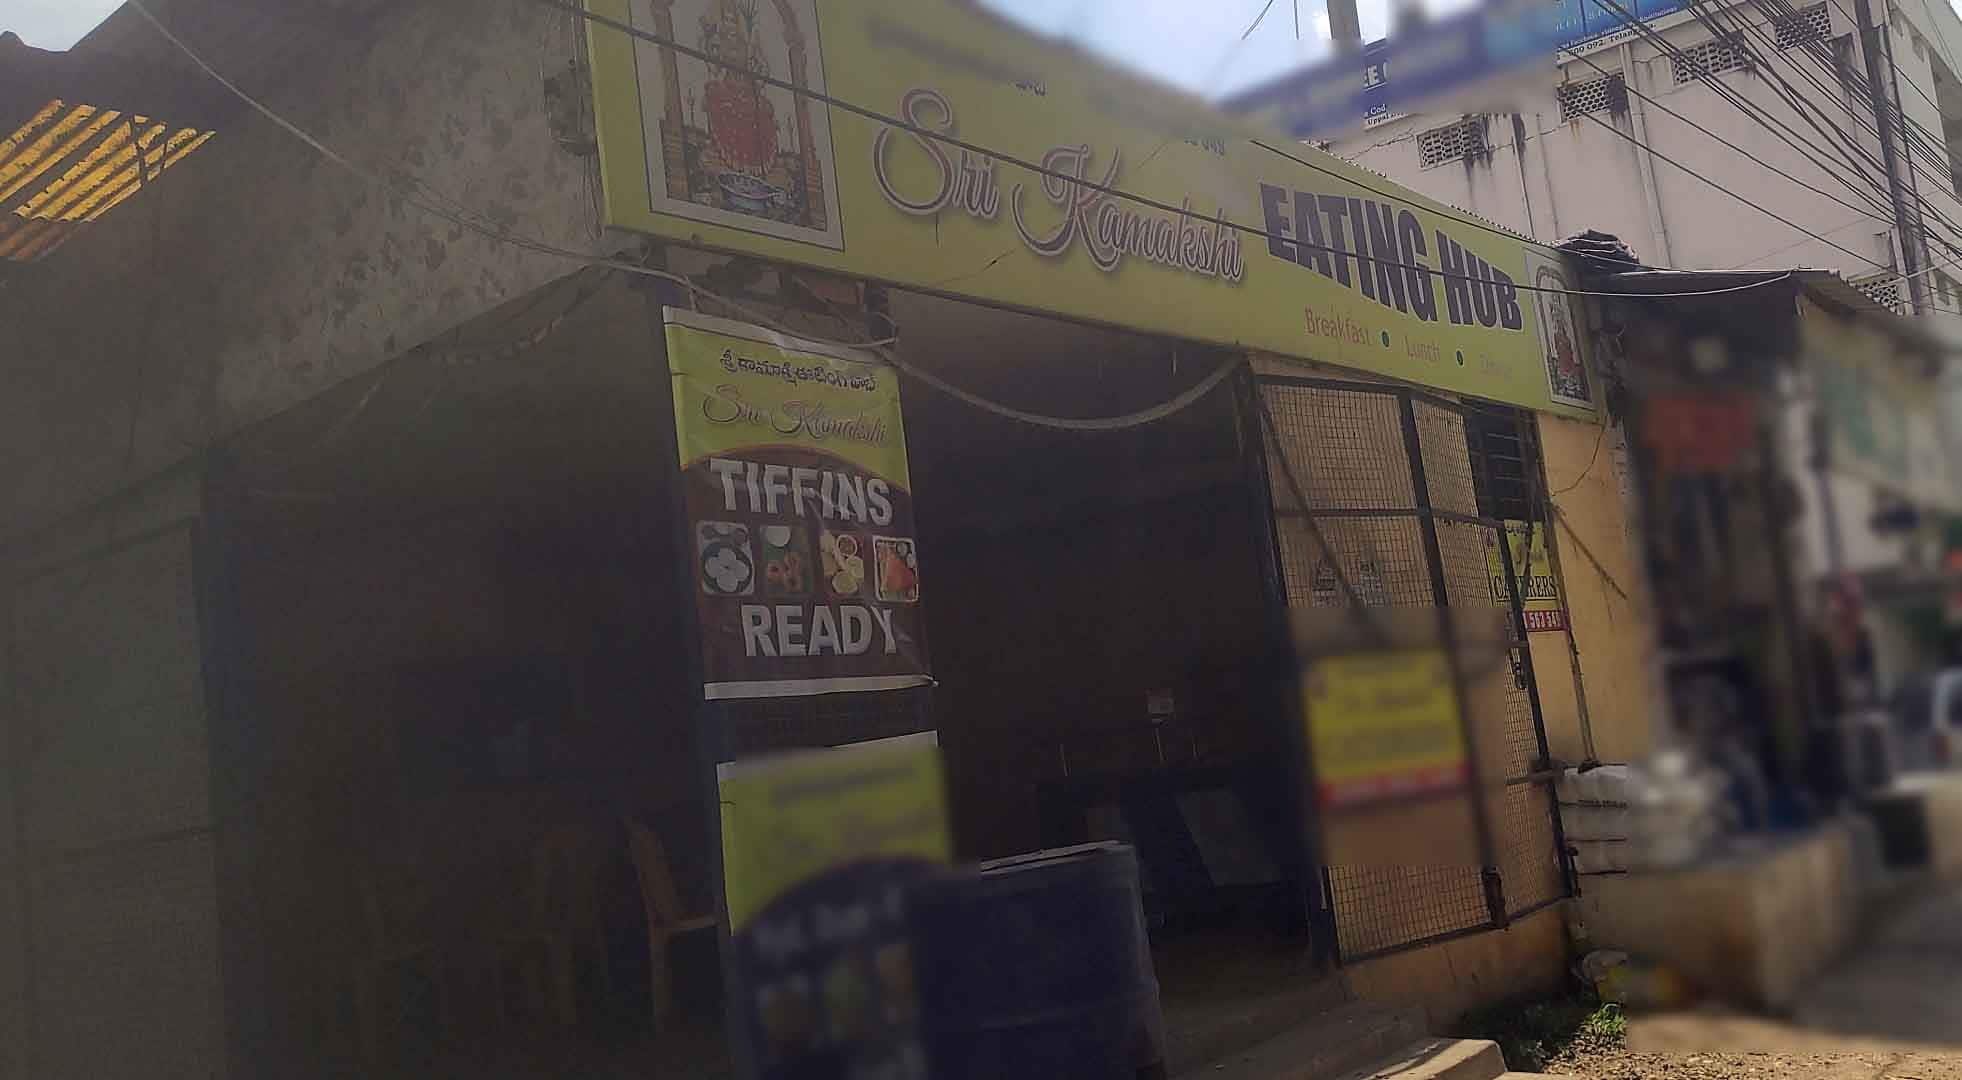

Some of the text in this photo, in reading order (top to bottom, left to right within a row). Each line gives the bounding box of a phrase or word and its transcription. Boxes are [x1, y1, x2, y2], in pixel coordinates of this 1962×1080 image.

[872, 88, 1244, 282] Sri Kamakshi
[1260, 182, 1523, 330] EATING HUB
[1304, 305, 1372, 346] Breakfast
[710, 458, 893, 526] TIFFINS
[741, 604, 897, 657] READY
